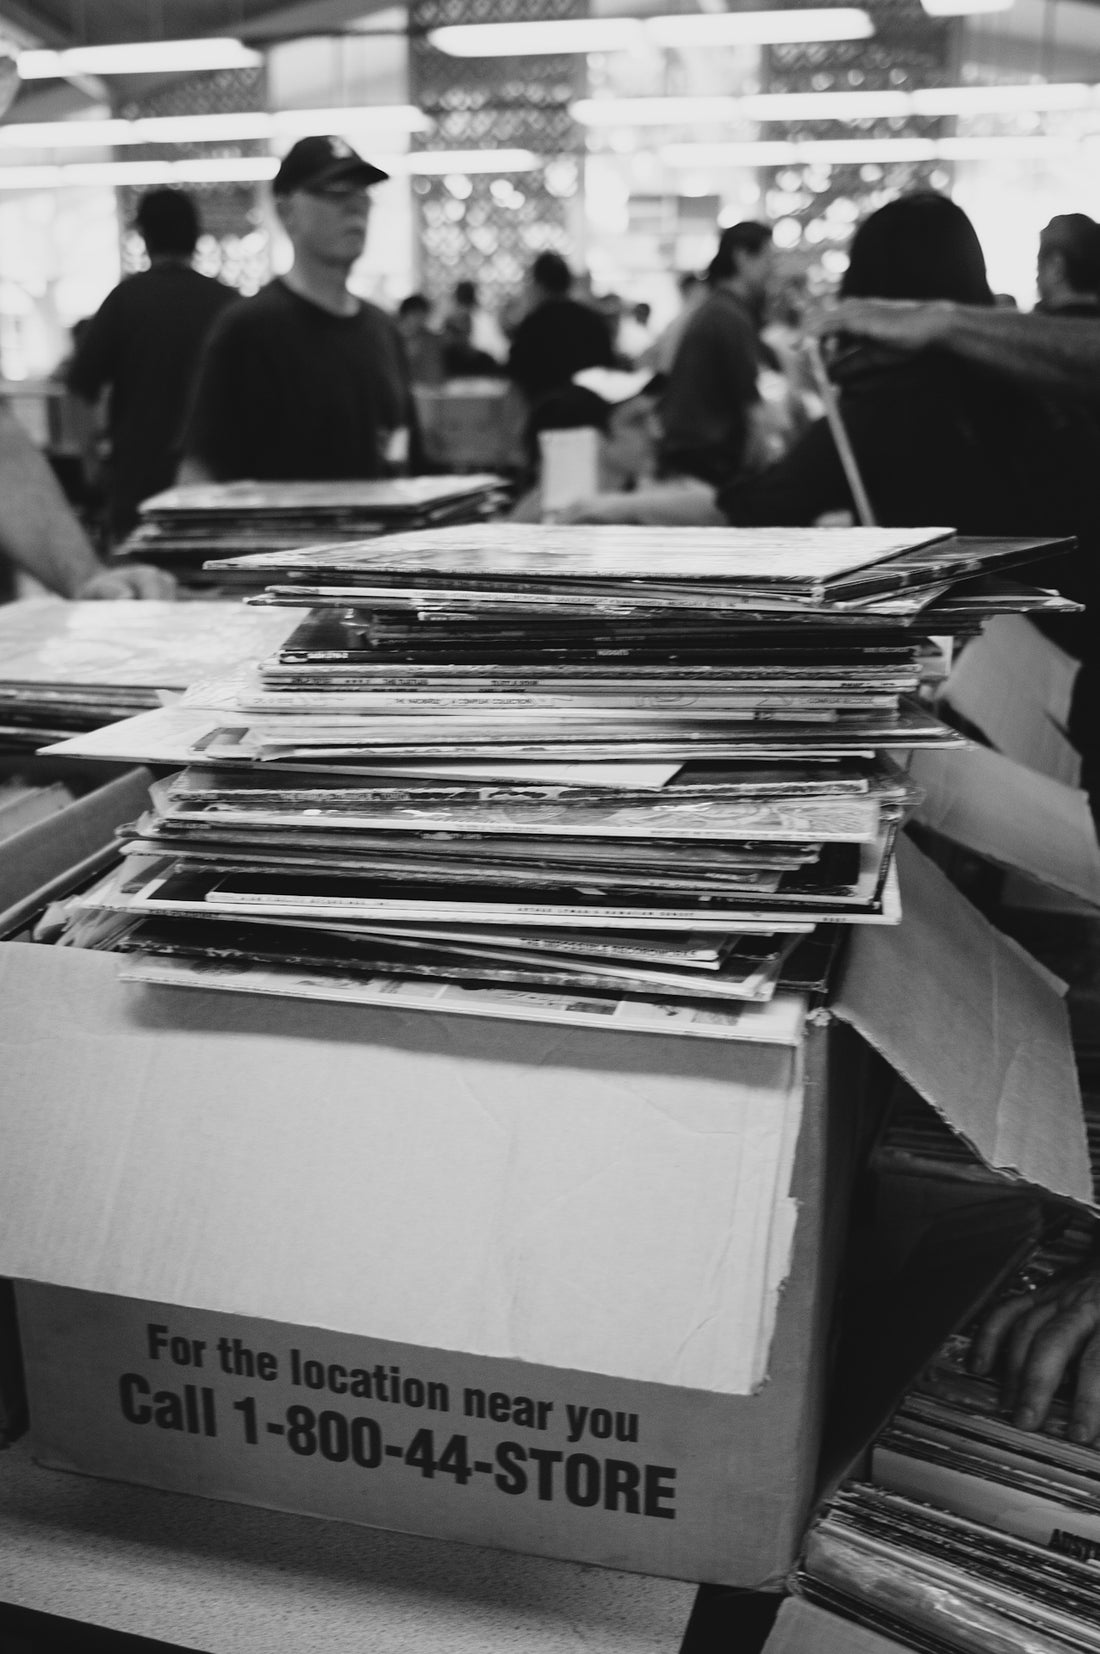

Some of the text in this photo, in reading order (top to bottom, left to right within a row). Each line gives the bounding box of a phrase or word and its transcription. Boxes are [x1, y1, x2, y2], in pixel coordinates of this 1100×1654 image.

[115, 1372, 677, 1520] Call 1-800-44-STORE
[147, 1322, 639, 1443] For the location near you
